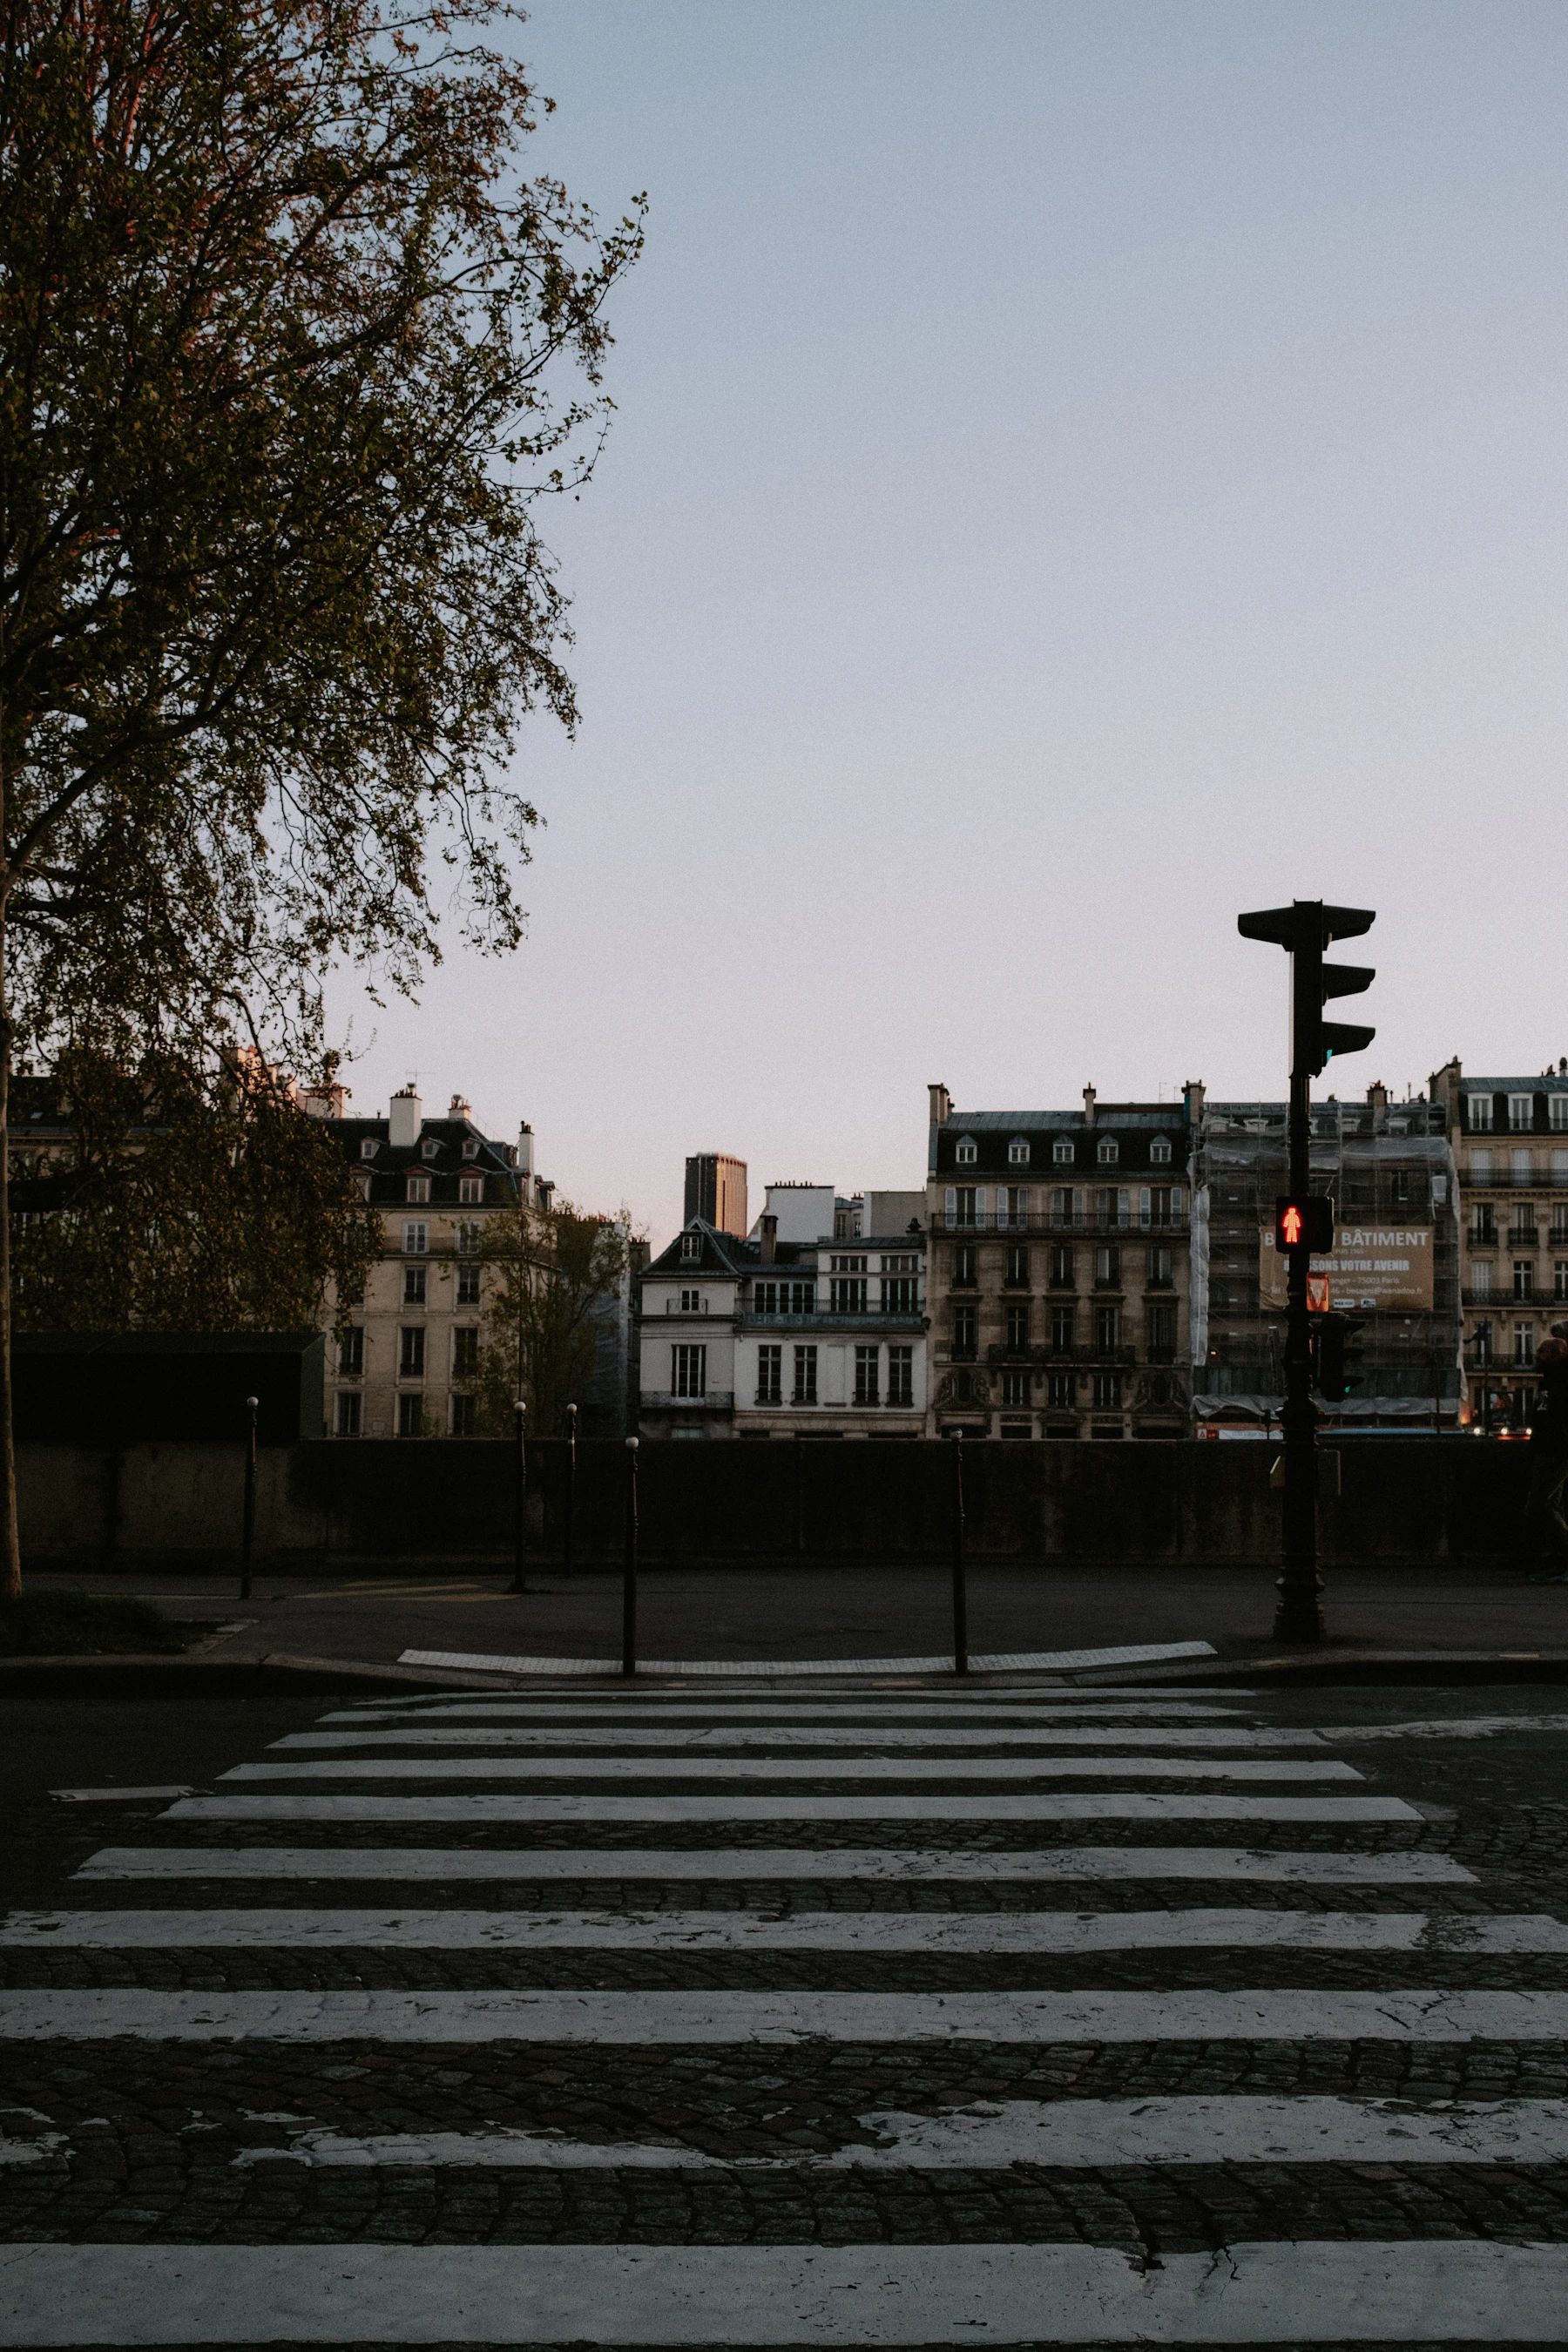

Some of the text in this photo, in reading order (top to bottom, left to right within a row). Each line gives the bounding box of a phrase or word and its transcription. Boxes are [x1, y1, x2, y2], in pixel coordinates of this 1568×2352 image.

[1341, 1228, 1429, 1247] BÂTIMENT
[1340, 1260, 1373, 1272] VOTRE
[1374, 1260, 1410, 1272] AVENIR
